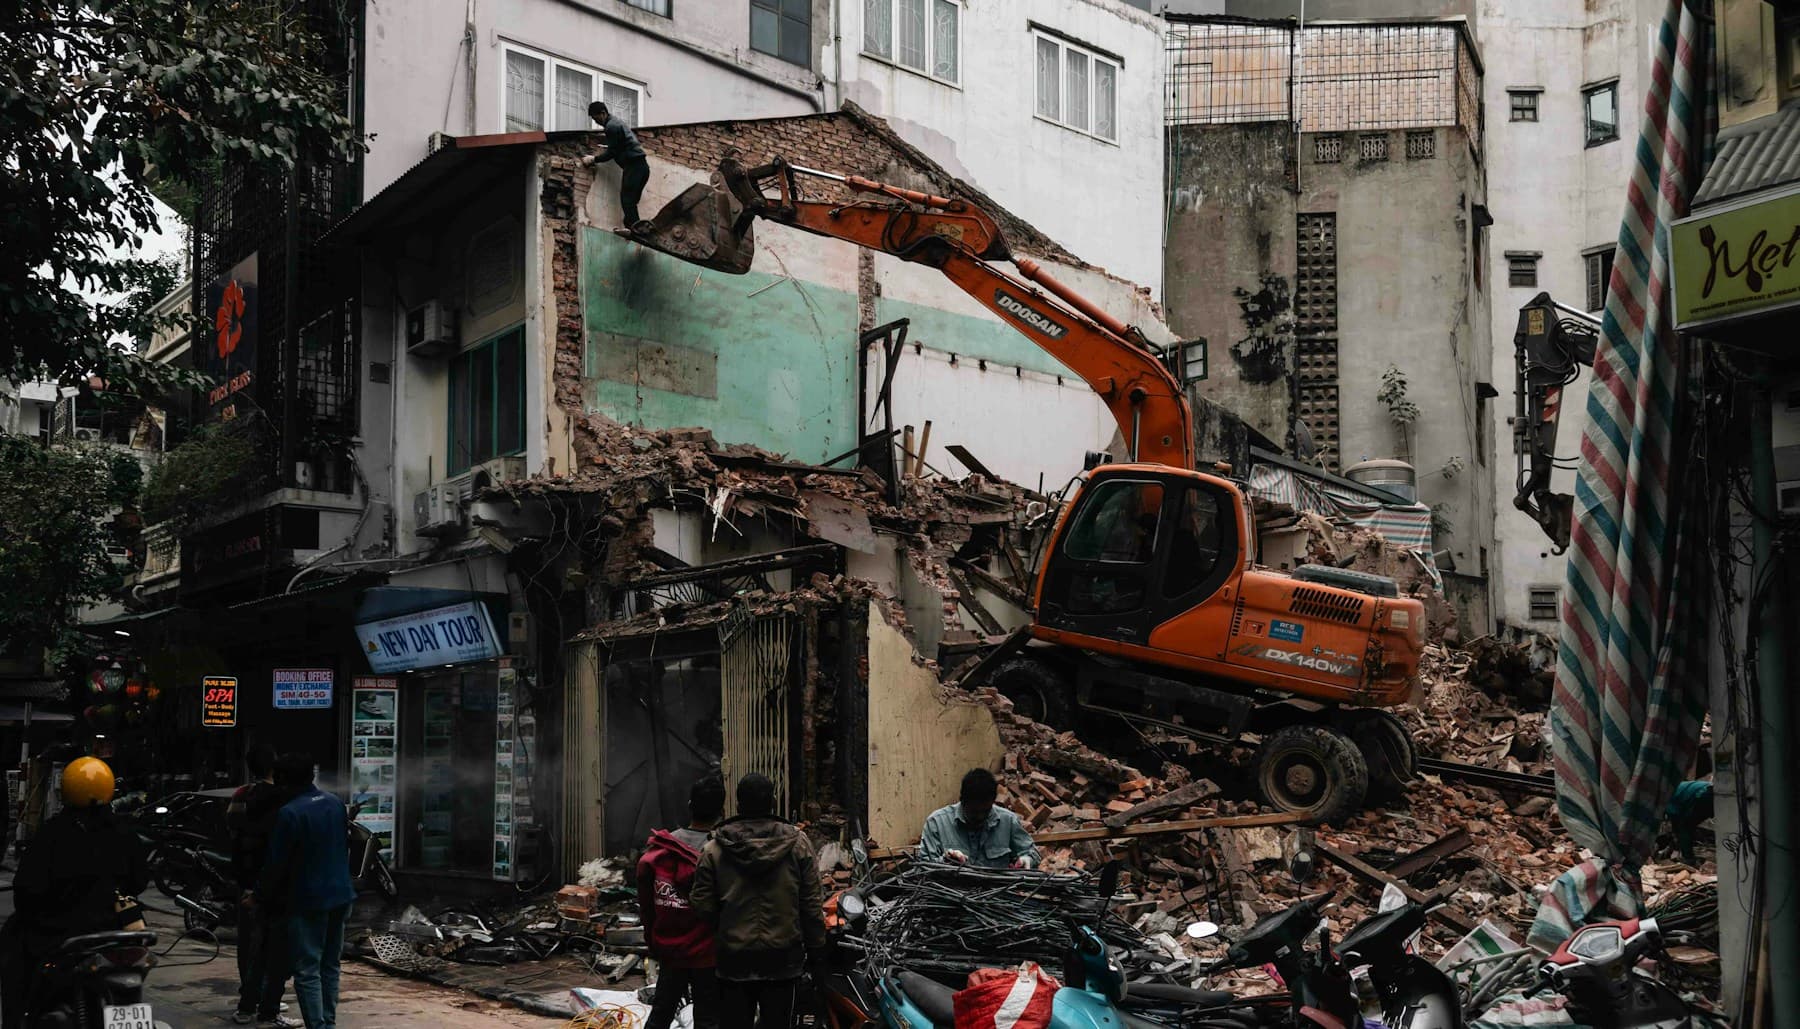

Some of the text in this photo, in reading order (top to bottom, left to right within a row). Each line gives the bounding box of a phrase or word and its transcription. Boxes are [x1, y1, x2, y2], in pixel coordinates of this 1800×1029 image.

[998, 295, 1063, 337] DOOSAN
[378, 629, 410, 658] NEW
[408, 624, 441, 654] DAY
[438, 615, 485, 649] TOUR
[275, 671, 332, 682] BOOKING OFFICE
[276, 682, 331, 691] MONEY EXCHANGE
[204, 688, 235, 703] SPA
[280, 691, 296, 699] SIM
